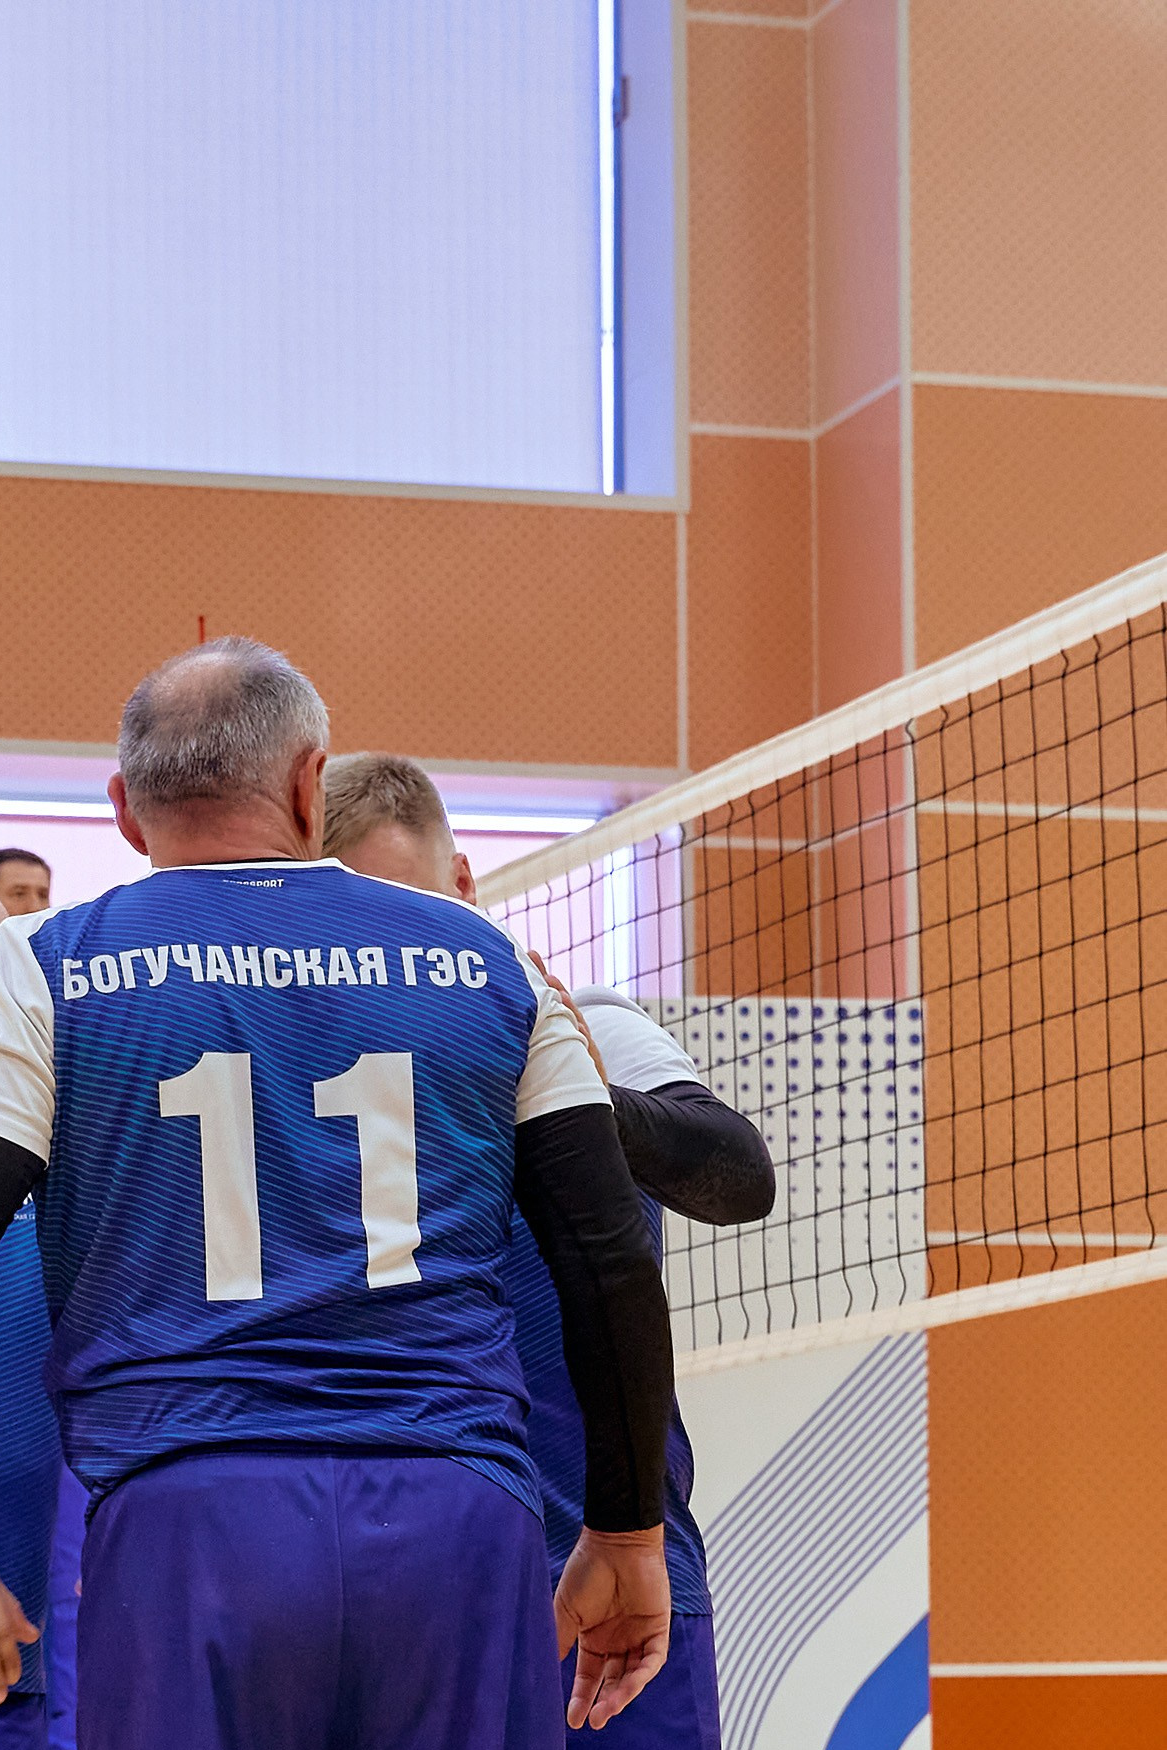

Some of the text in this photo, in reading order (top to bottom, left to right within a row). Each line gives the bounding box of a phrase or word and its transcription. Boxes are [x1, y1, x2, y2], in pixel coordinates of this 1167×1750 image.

[63, 943, 489, 1001] БОГУЧАНСКАЯ ГЭС
[158, 1051, 423, 1302] 11
